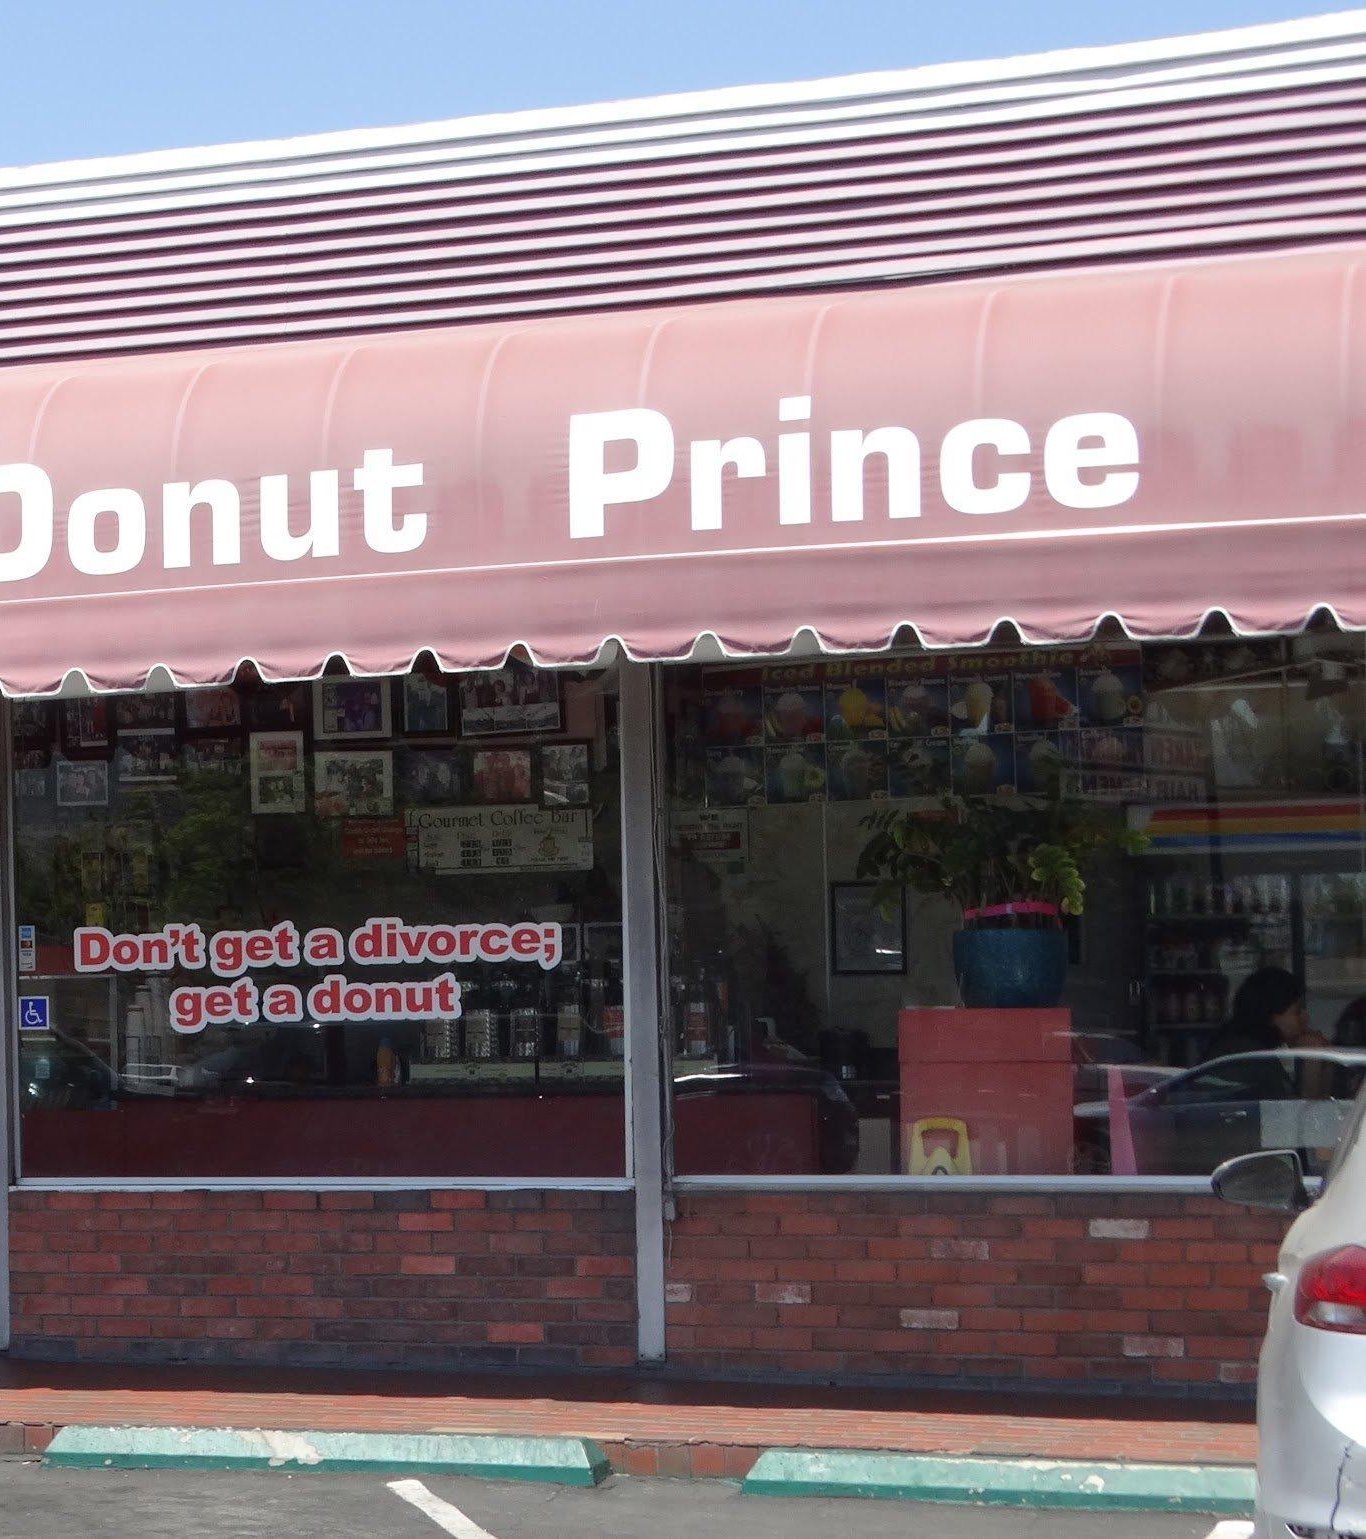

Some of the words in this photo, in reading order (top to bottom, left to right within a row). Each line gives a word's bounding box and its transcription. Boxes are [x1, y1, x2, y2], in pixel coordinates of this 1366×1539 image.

[569, 395, 1140, 539] Prince
[762, 665, 816, 681] Iced
[825, 655, 937, 678] Blended
[418, 812, 485, 829] Gourmet
[490, 808, 544, 826] Coffee
[77, 928, 202, 968] Don't
[215, 926, 294, 972] get
[308, 933, 339, 961] a
[353, 922, 557, 964] divorce;
[174, 982, 253, 1027] get
[268, 990, 297, 1016] a
[311, 978, 456, 1014] donut
